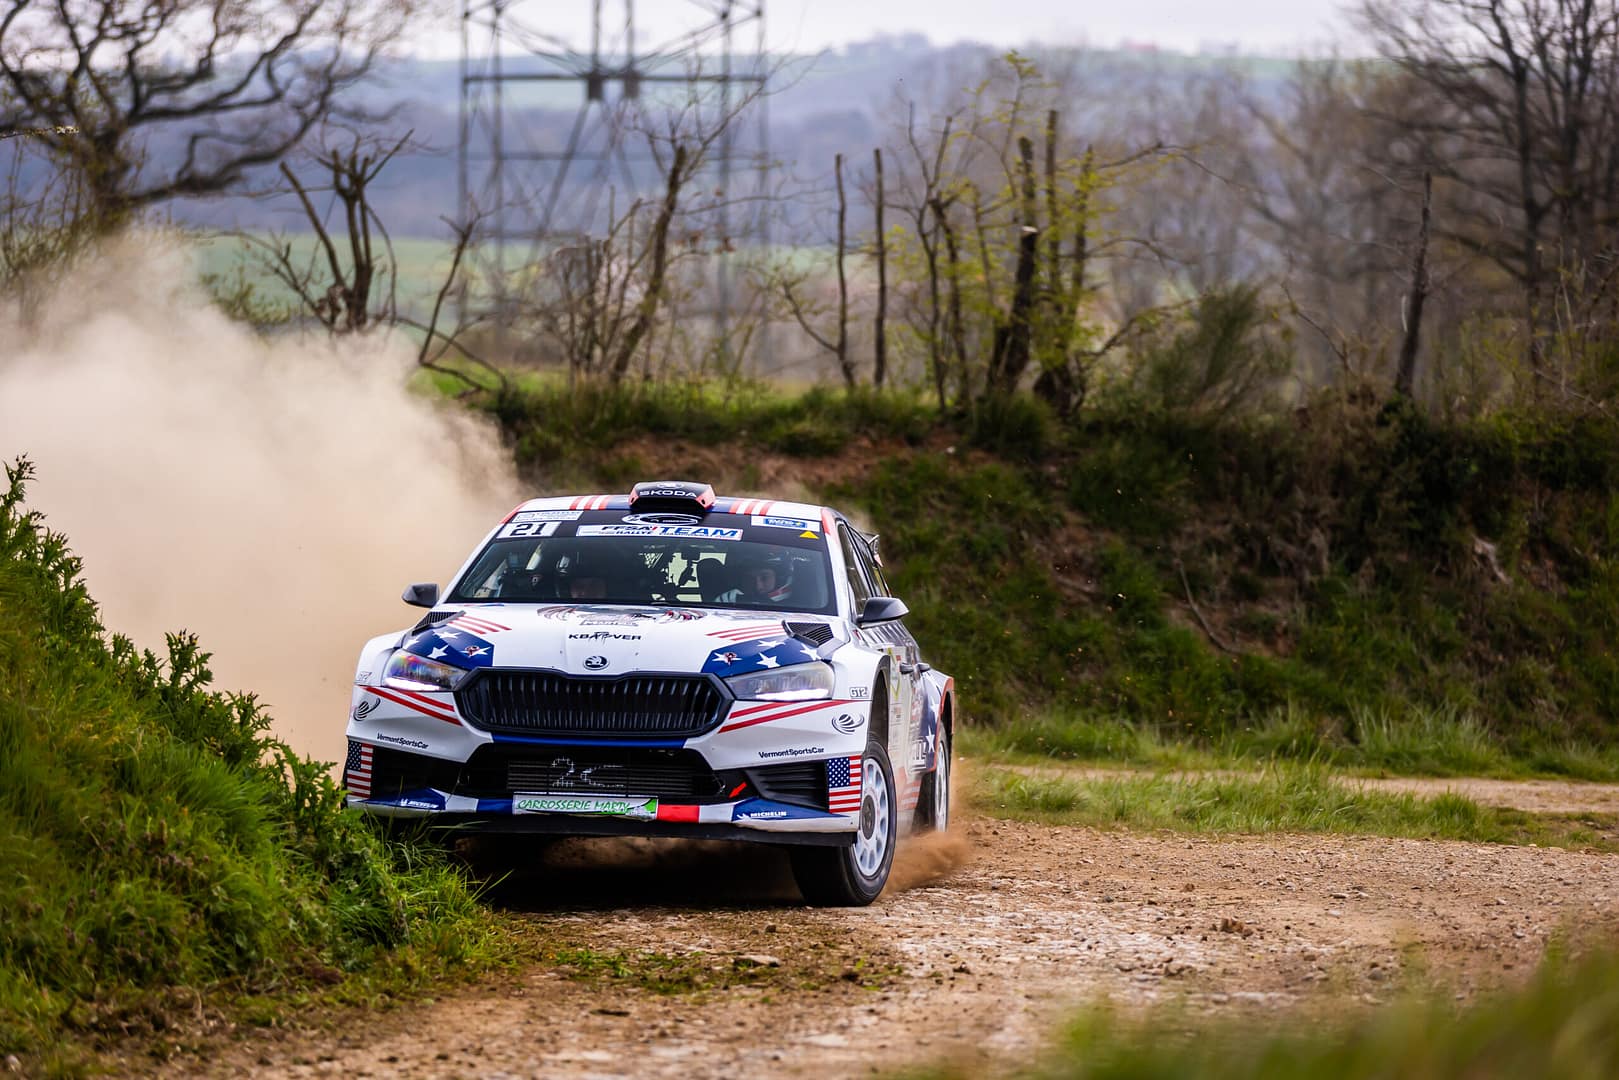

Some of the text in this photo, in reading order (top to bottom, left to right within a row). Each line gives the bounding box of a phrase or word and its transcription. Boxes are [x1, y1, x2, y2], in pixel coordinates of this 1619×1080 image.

[639, 489, 697, 498] SKODA
[510, 522, 548, 537] 21
[657, 526, 739, 537] TEAM
[377, 732, 430, 749] VermontSportsCar
[758, 747, 825, 759] VermontSportsCar
[518, 799, 592, 810] CARROSSERIE
[750, 811, 788, 819] MICHELIN
